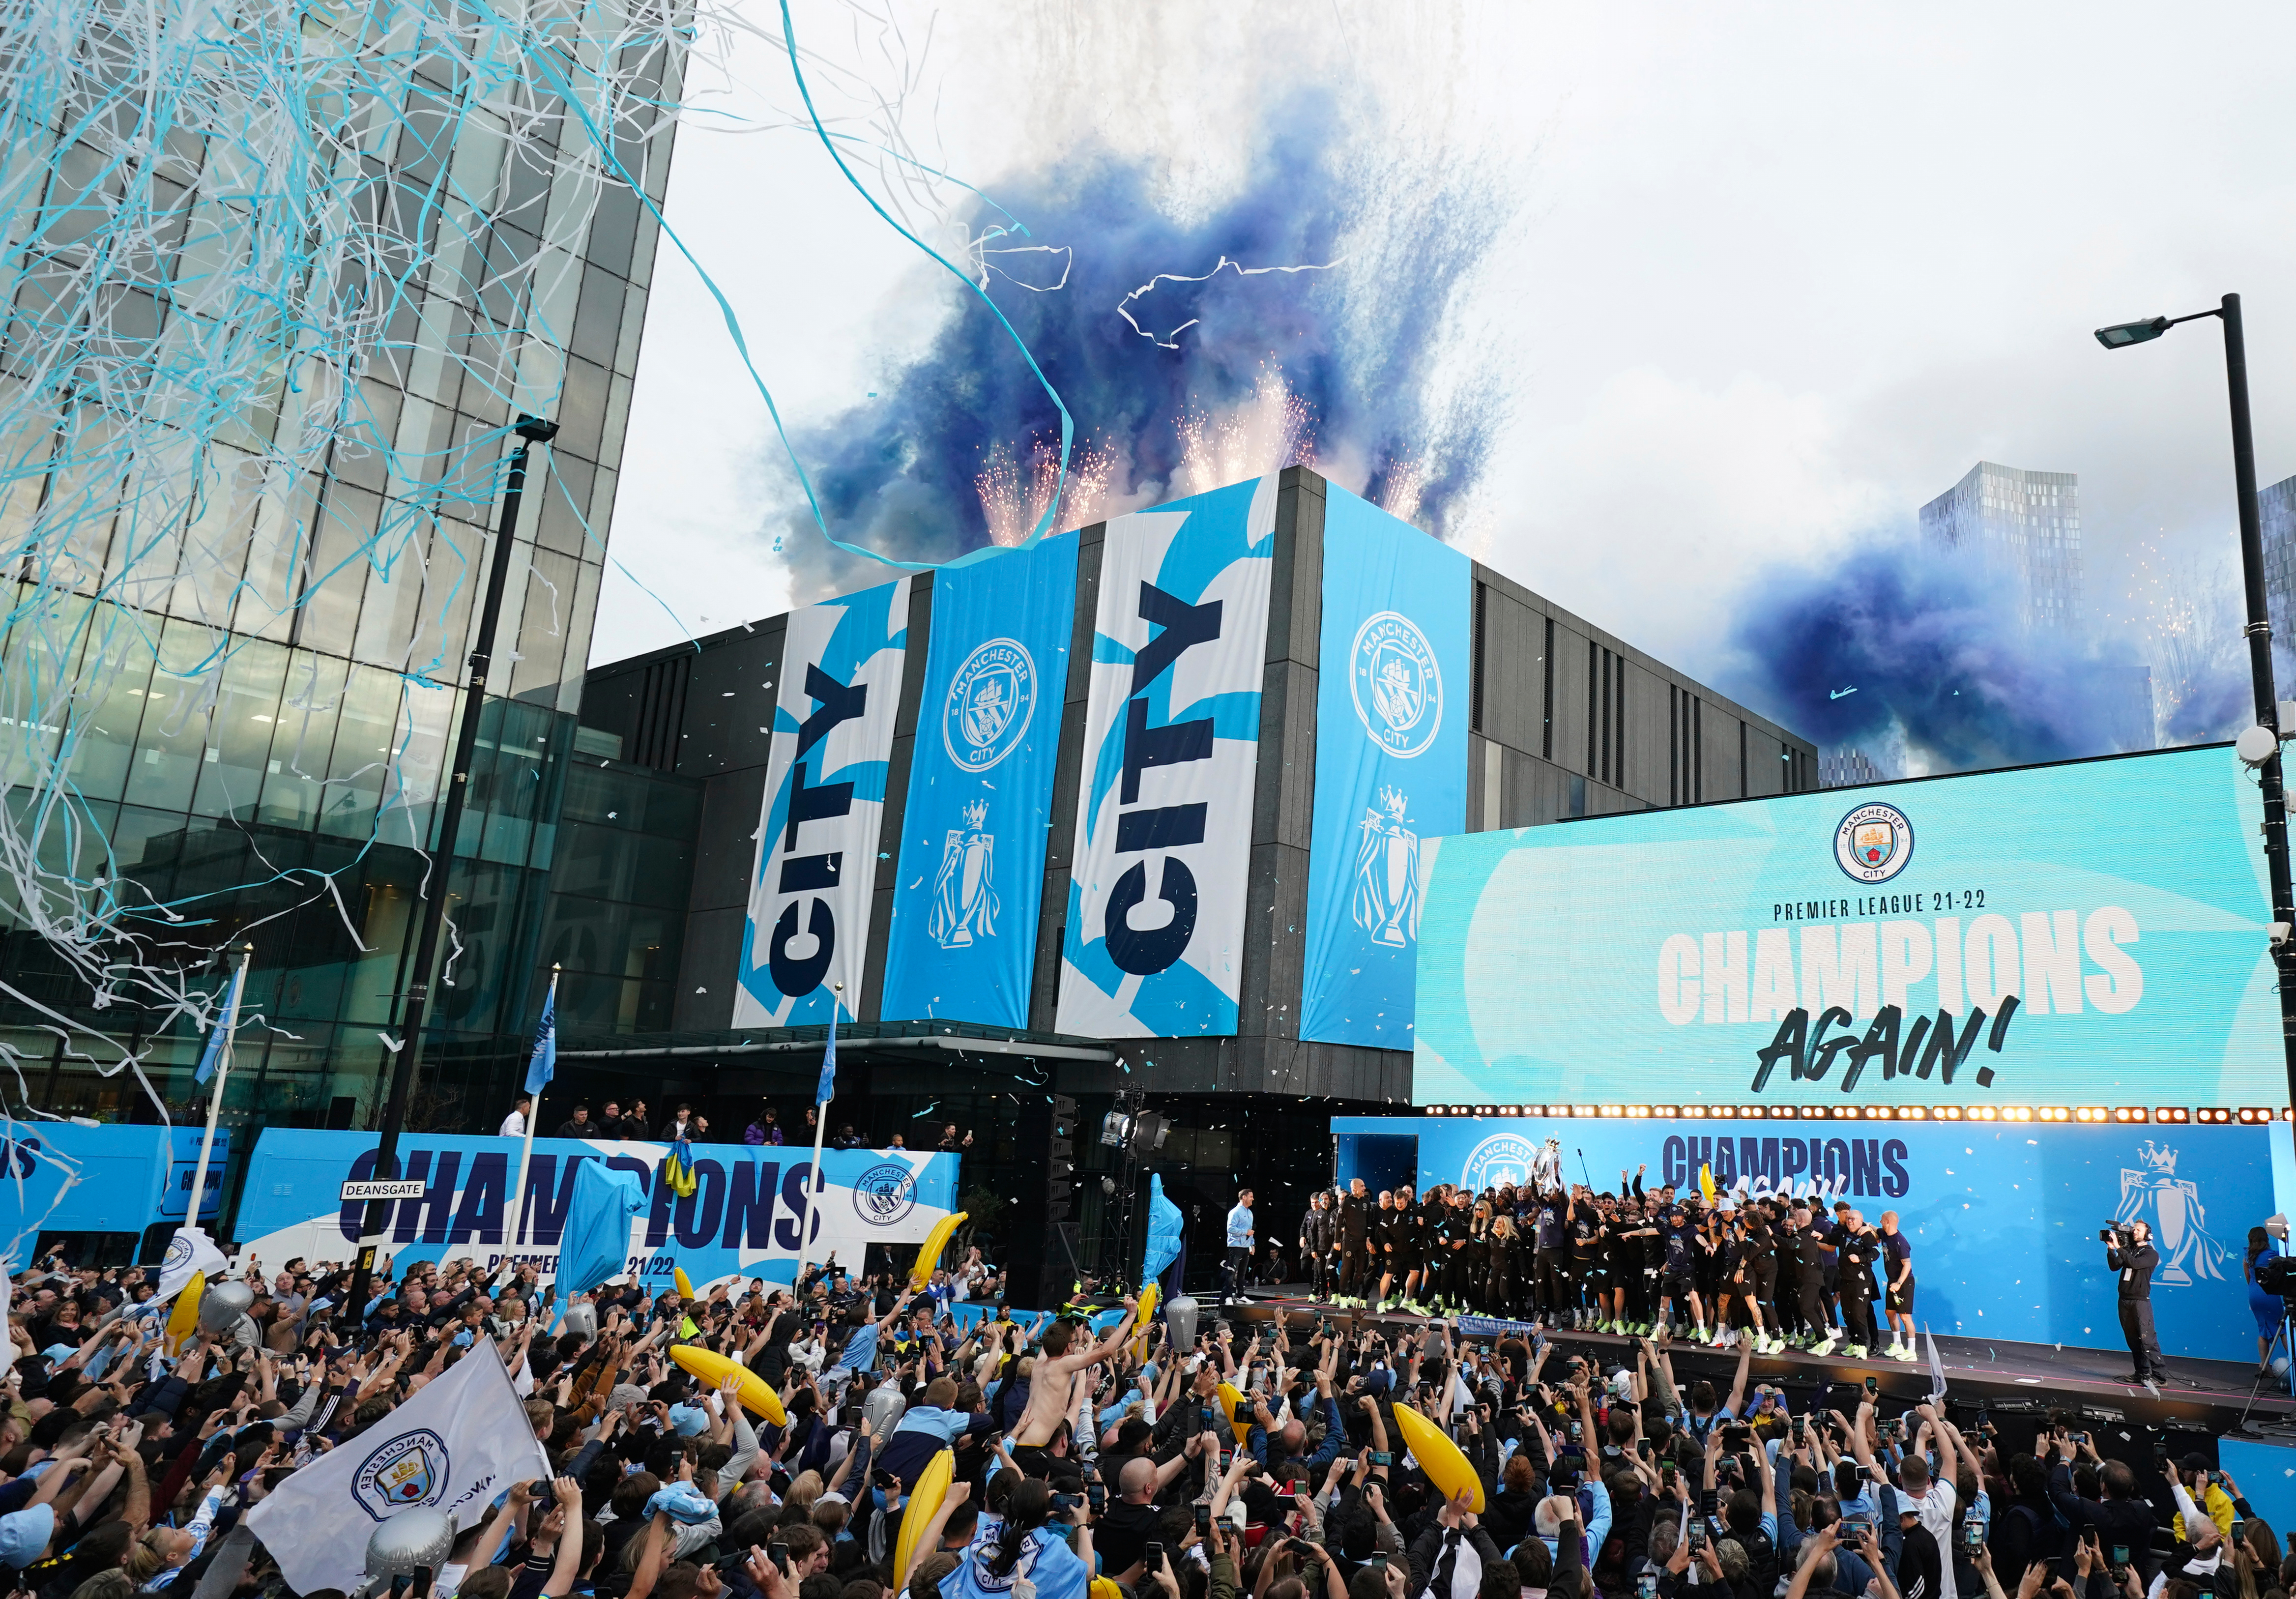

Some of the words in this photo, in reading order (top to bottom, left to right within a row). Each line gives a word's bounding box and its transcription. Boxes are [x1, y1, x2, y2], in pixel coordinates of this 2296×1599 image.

[1363, 623, 1433, 680] MANCHESTER
[957, 648, 1028, 695] MANCHESTER
[1359, 667, 1367, 676] 18
[1020, 694, 1029, 702] 94
[1427, 694, 1436, 703] 94
[1384, 728, 1409, 748] CITY
[970, 746, 996, 762] CITY
[1104, 581, 1223, 976] CITY
[769, 663, 868, 997] CITY
[1842, 809, 1904, 835] MANCHESTER
[1863, 870, 1886, 878] CITY
[1774, 899, 1848, 921] PREMIER
[1859, 894, 1923, 916] LEAGUE
[1934, 889, 1985, 911] 21-22
[1658, 905, 2144, 1026] CHAMPIONS
[1751, 995, 2021, 1093] AGAIN!
[1472, 1141, 1535, 1174] MANCHEST
[1663, 1135, 1909, 1198] CHAMPIONS
[346, 1185, 421, 1195] DEANSGATE
[862, 1169, 911, 1188] MANCHESTER
[627, 1256, 674, 1276] 21/22
[982, 1574, 1005, 1586] CITY
